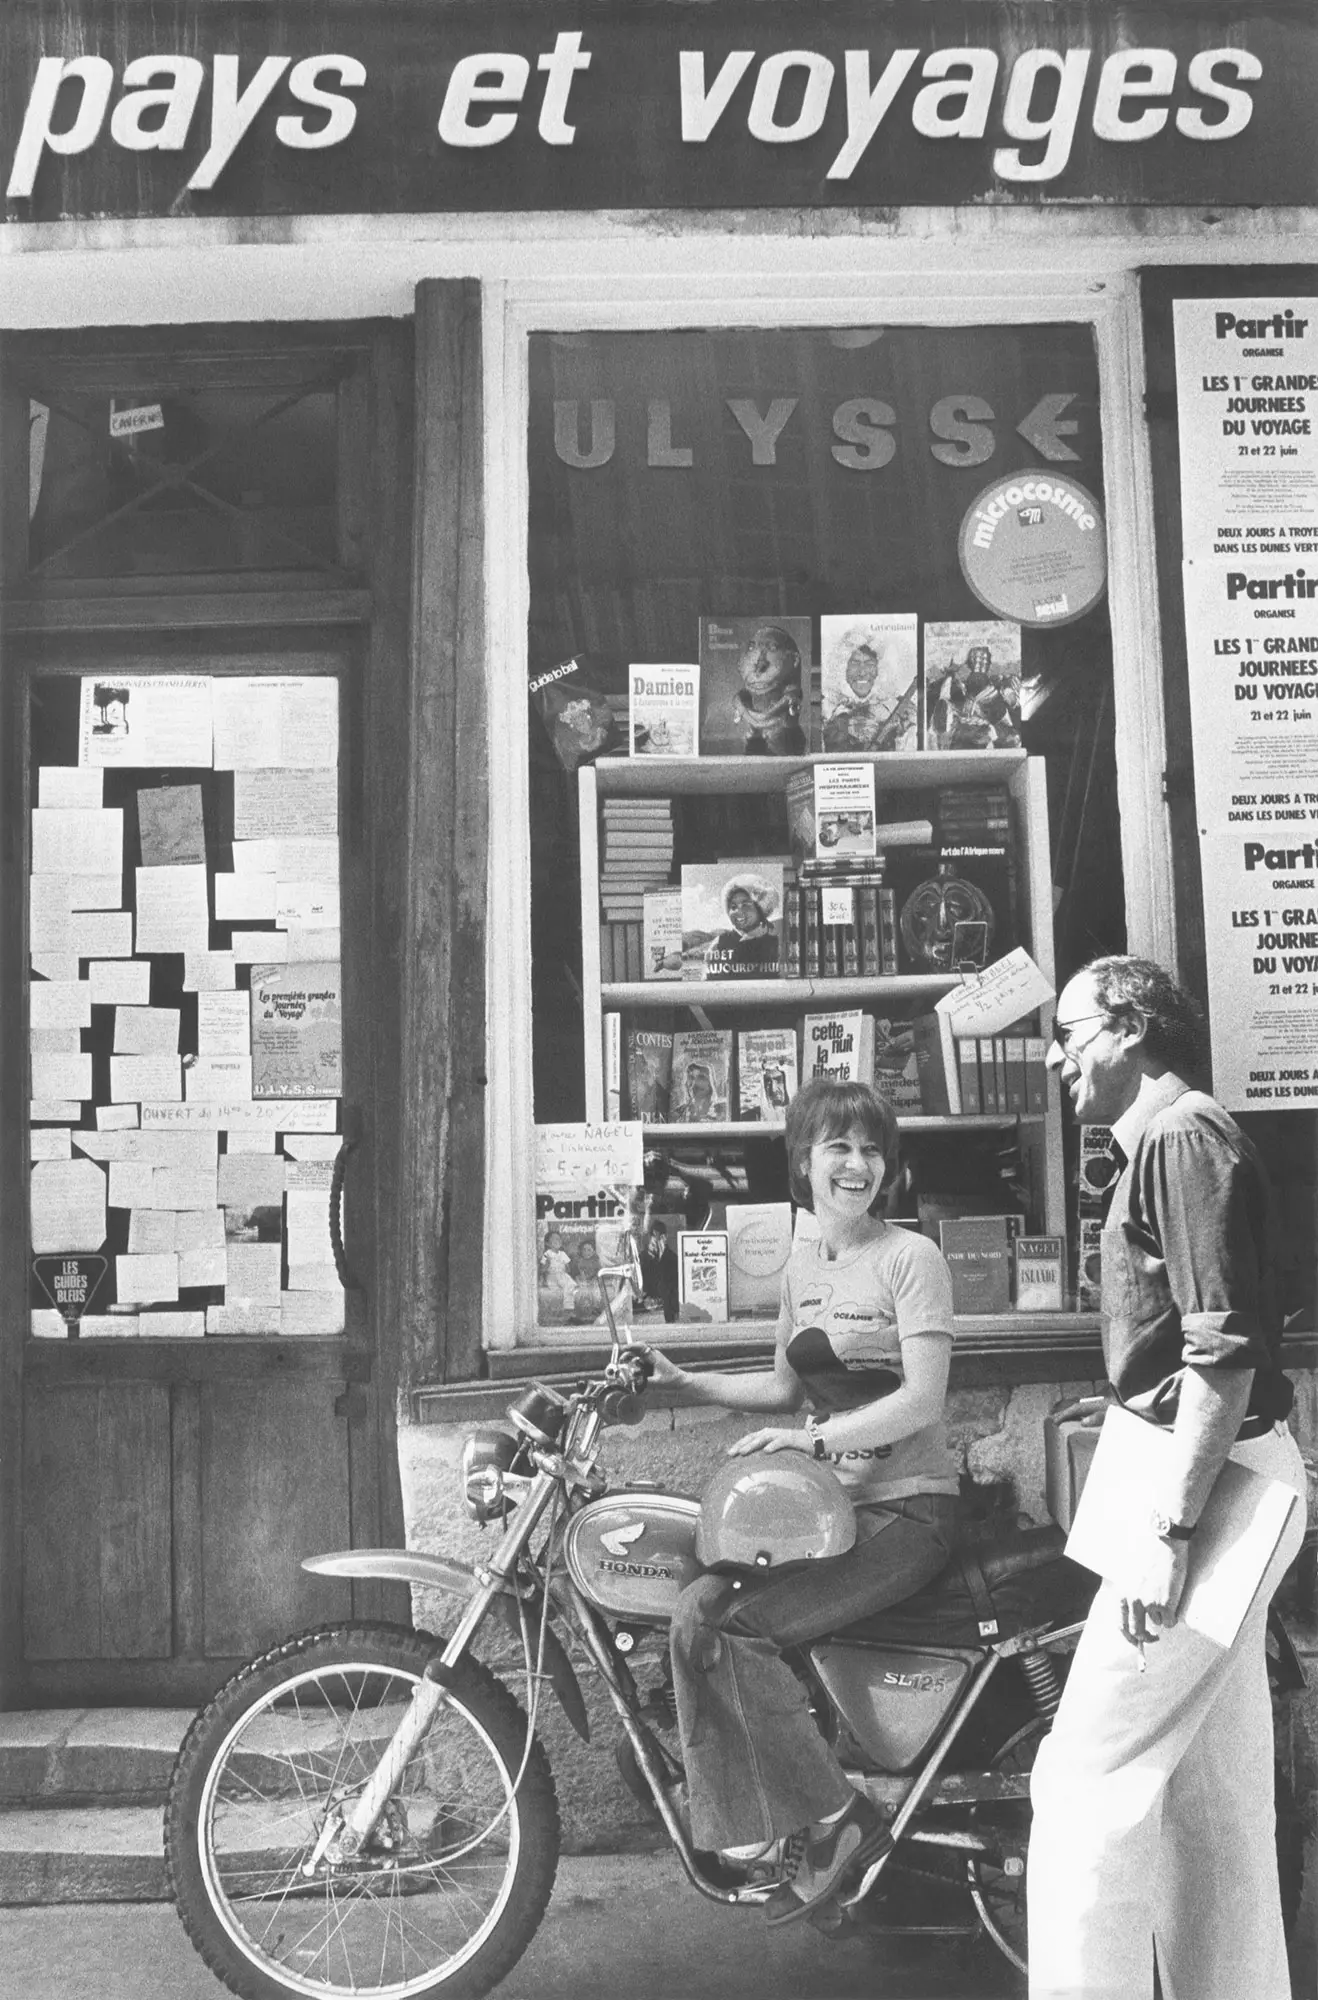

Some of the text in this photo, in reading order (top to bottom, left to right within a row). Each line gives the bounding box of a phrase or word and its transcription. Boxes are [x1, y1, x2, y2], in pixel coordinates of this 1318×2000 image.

[5, 31, 1263, 197] pays et voyages
[1215, 309, 1308, 338] Partir
[1242, 348, 1284, 357] ORGANISE
[1202, 376, 1229, 392] LES
[1226, 397, 1305, 413] JOURNEES
[553, 392, 1082, 470] ULYSSE
[1222, 419, 1311, 436] DU VOYAGE
[1238, 445, 1298, 457] 21 et 22 juin
[972, 482, 1096, 549] microcosme
[1217, 527, 1242, 538] DEUX
[1245, 527, 1275, 538] JOURS
[1278, 527, 1286, 537] A
[1213, 543, 1239, 553] DANS
[1242, 542, 1257, 553] LES
[1260, 542, 1290, 553] DUNES
[1226, 568, 1318, 600] Partir
[1254, 609, 1296, 619] ORGANISE
[1214, 639, 1241, 655] LES
[1238, 660, 1318, 677] JOURNEES
[633, 677, 695, 696] Damien
[1234, 684, 1258, 701] DU
[1251, 710, 1311, 722] 21 et 22 juin
[1232, 795, 1257, 805] DEUX
[1260, 794, 1290, 805] JOURS
[1294, 794, 1301, 804] A
[1228, 811, 1254, 822] DANS
[1256, 811, 1272, 821] LES
[1274, 810, 1306, 820] DUNES
[941, 847, 951, 857] Art
[1272, 879, 1315, 889] ORGANISE
[1232, 910, 1259, 928] LES
[702, 949, 734, 961] TIBET
[1253, 957, 1276, 974] DU
[1269, 984, 1308, 995] 21 et 22
[259, 990, 270, 1004] Les
[307, 990, 336, 1004] grandes
[263, 1010, 273, 1019] du
[812, 1021, 844, 1041] cette
[636, 1032, 672, 1049] CONTES
[832, 1033, 853, 1054] nuit
[816, 1045, 828, 1064] la
[812, 1061, 851, 1082] liberté
[1250, 1071, 1275, 1082] DEUX
[1278, 1071, 1309, 1081] JOURS
[1246, 1087, 1272, 1098] DANS
[1274, 1087, 1291, 1097] LES
[143, 1106, 193, 1120] OUVERT
[584, 1125, 633, 1140] NAGEL
[62, 1261, 78, 1275] LES
[54, 1275, 88, 1289] GUIDES
[57, 1289, 86, 1303] BLEUS
[833, 1312, 873, 1321] OCEANIE
[599, 1560, 674, 1580] HONDA
